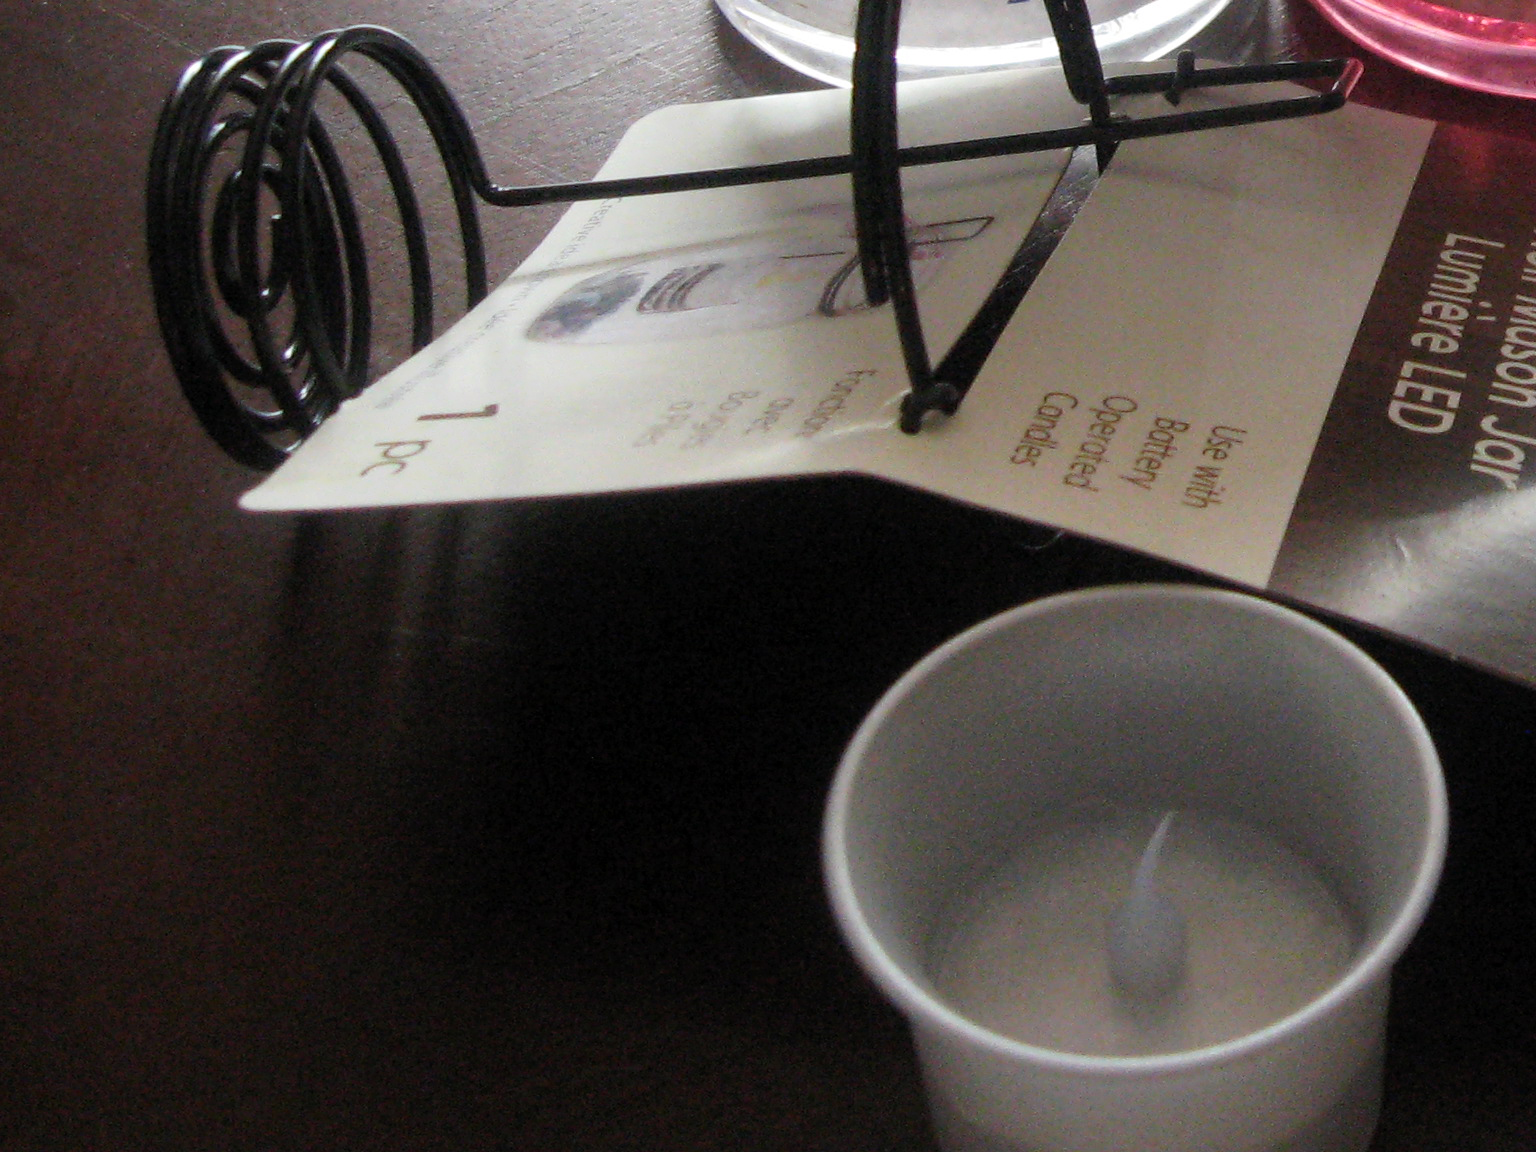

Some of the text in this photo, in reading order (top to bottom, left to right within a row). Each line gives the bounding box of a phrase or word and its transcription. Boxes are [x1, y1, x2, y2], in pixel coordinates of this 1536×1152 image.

[1387, 232, 1506, 435] Lumière LED
[417, 403, 499, 421] 1
[1010, 392, 1078, 467] Candles
[1063, 395, 1138, 492] Operated
[360, 439, 432, 476] pc
[1120, 417, 1190, 491] Battery
[1182, 425, 1248, 509] Use with
